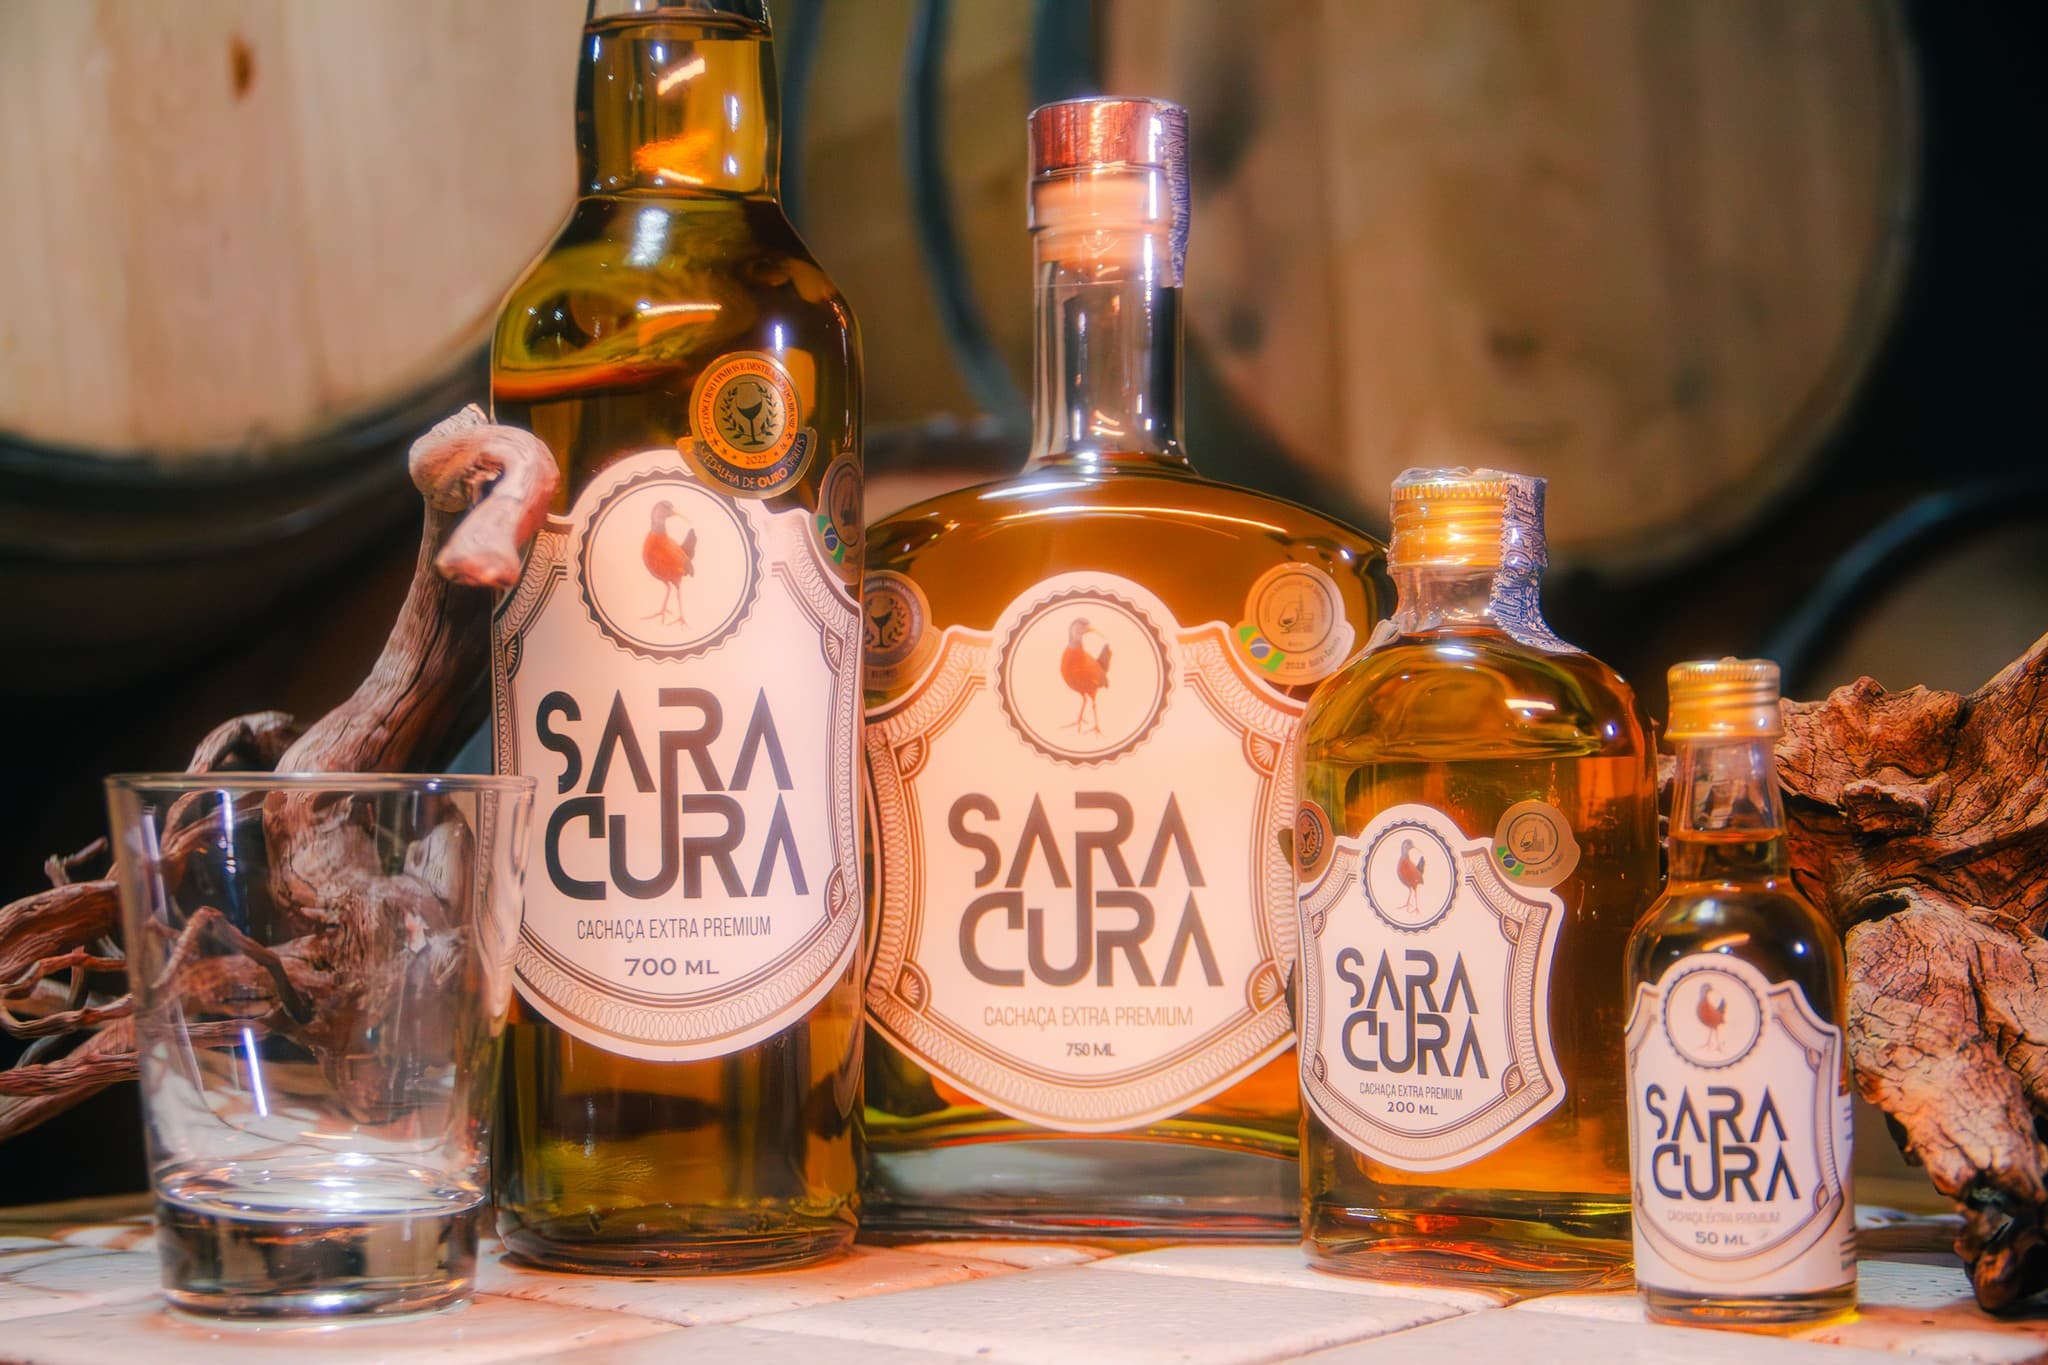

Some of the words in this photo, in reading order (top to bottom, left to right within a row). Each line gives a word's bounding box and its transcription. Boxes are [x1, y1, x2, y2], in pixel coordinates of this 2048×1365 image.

[745, 456, 767, 465] 2022
[742, 477, 755, 488] DE
[757, 468, 788, 488] OURO
[536, 686, 794, 795] SARA
[545, 792, 810, 900] CURA
[948, 790, 1207, 889] SARA
[576, 918, 646, 943] CACHAÇA
[649, 917, 700, 940] EXTRA
[702, 915, 772, 938] PREMIUM
[959, 889, 1225, 988] CURA
[624, 957, 677, 977] 700
[685, 959, 720, 976] ML
[1335, 946, 1481, 1015] SARA
[983, 1005, 1057, 1031] CACHAÇA
[1062, 1006, 1110, 1027] EXTRA
[1115, 1006, 1193, 1027] PREMIUM
[1065, 1042, 1091, 1057] 750
[1093, 1042, 1117, 1057] ML
[1341, 1009, 1490, 1079] CURA
[1359, 1081, 1397, 1098] CACHAÇA
[1398, 1084, 1424, 1098] EXTRA
[1425, 1086, 1463, 1100] PREMIUM
[1387, 1101, 1416, 1114] 200
[1419, 1105, 1439, 1115] ML
[1645, 1083, 1789, 1144] SARA
[1652, 1142, 1801, 1202] CURA
[1695, 1230, 1719, 1245] 50
[1723, 1233, 1750, 1246] ML
